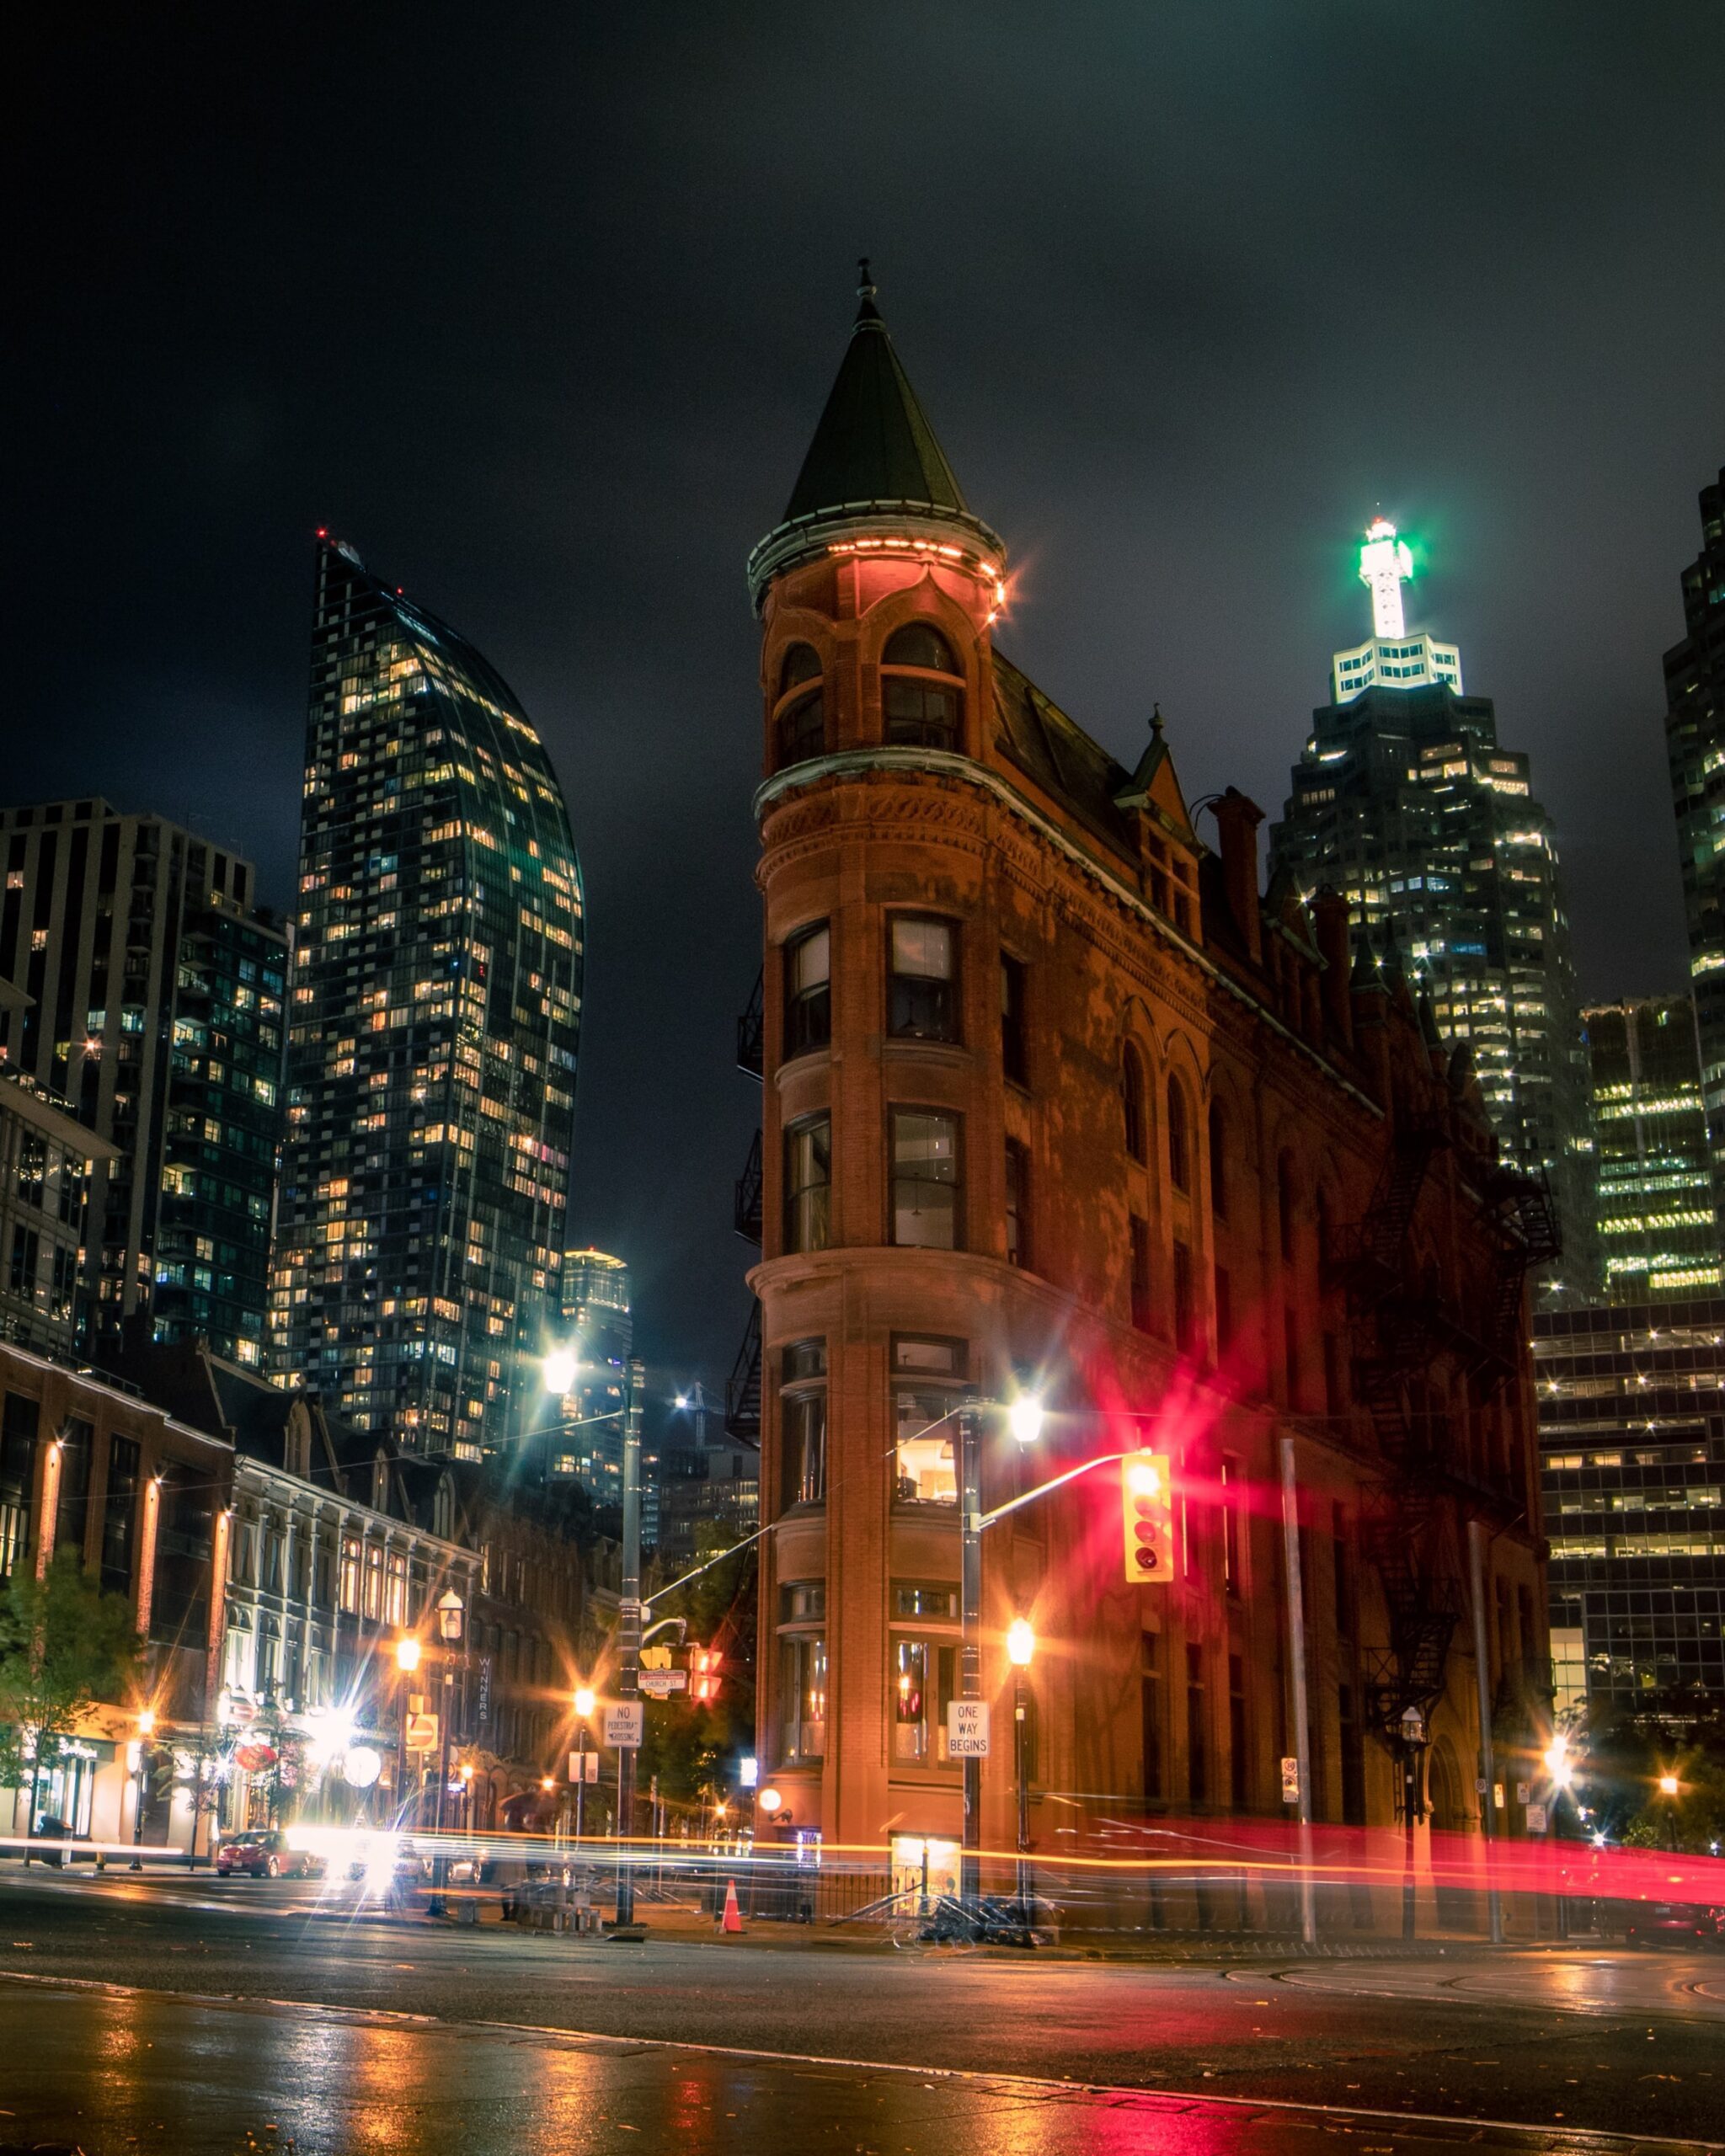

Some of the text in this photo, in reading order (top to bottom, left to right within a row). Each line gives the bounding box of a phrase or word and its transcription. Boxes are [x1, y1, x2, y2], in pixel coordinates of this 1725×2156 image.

[478, 1657, 490, 1720] WINNERS
[617, 1706, 630, 1719] NO
[958, 1706, 978, 1718] ONE
[959, 1723, 978, 1735] WAY
[950, 1739, 987, 1752] BEGINS
